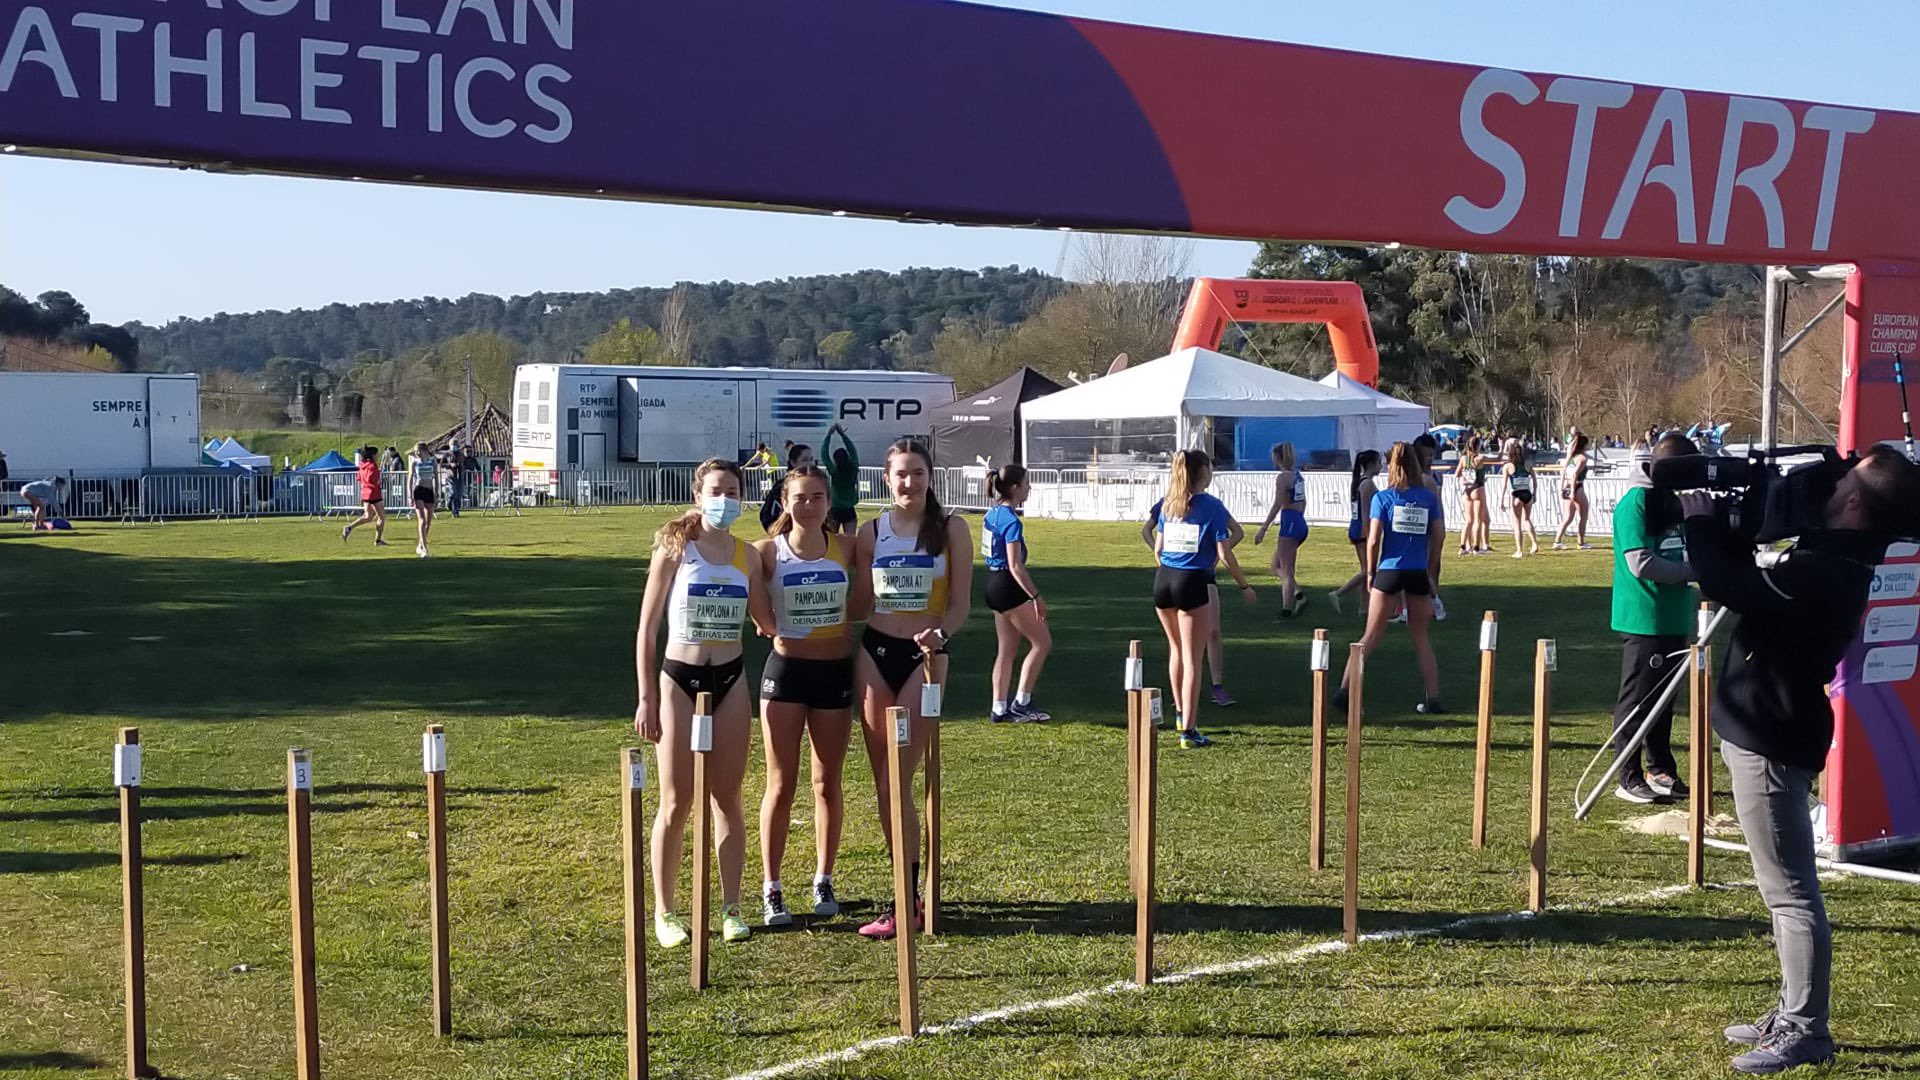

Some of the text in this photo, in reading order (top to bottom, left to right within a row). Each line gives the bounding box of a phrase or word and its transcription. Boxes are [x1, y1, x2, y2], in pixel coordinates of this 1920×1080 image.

[0, 7, 573, 143] ATHLETICS
[1443, 68, 1876, 251] START
[1873, 314, 1920, 326] EUROPEAN
[1872, 327, 1918, 340] CHAMPION
[1870, 341, 1917, 353] CLUBS CUP
[580, 383, 597, 393] RTP
[92, 400, 143, 412] SEMPRE
[580, 397, 615, 407] SEMPRE
[580, 410, 592, 418] AO
[839, 398, 922, 421] RTP
[531, 431, 552, 442] RTP
[882, 575, 923, 590] PAMPLONA AT
[1885, 572, 1916, 582] HOSPITAL
[1885, 583, 1894, 592] DA
[794, 590, 837, 606] PAMPLONA AT
[696, 604, 739, 618] PAMPLONA AT
[881, 601, 907, 609] OEIRAS
[792, 617, 822, 625] OEIRAS
[692, 630, 721, 639] OEIRAS
[1153, 702, 1160, 714] 6
[899, 724, 905, 737] 5
[297, 768, 306, 784] 3
[633, 769, 641, 785] 4
